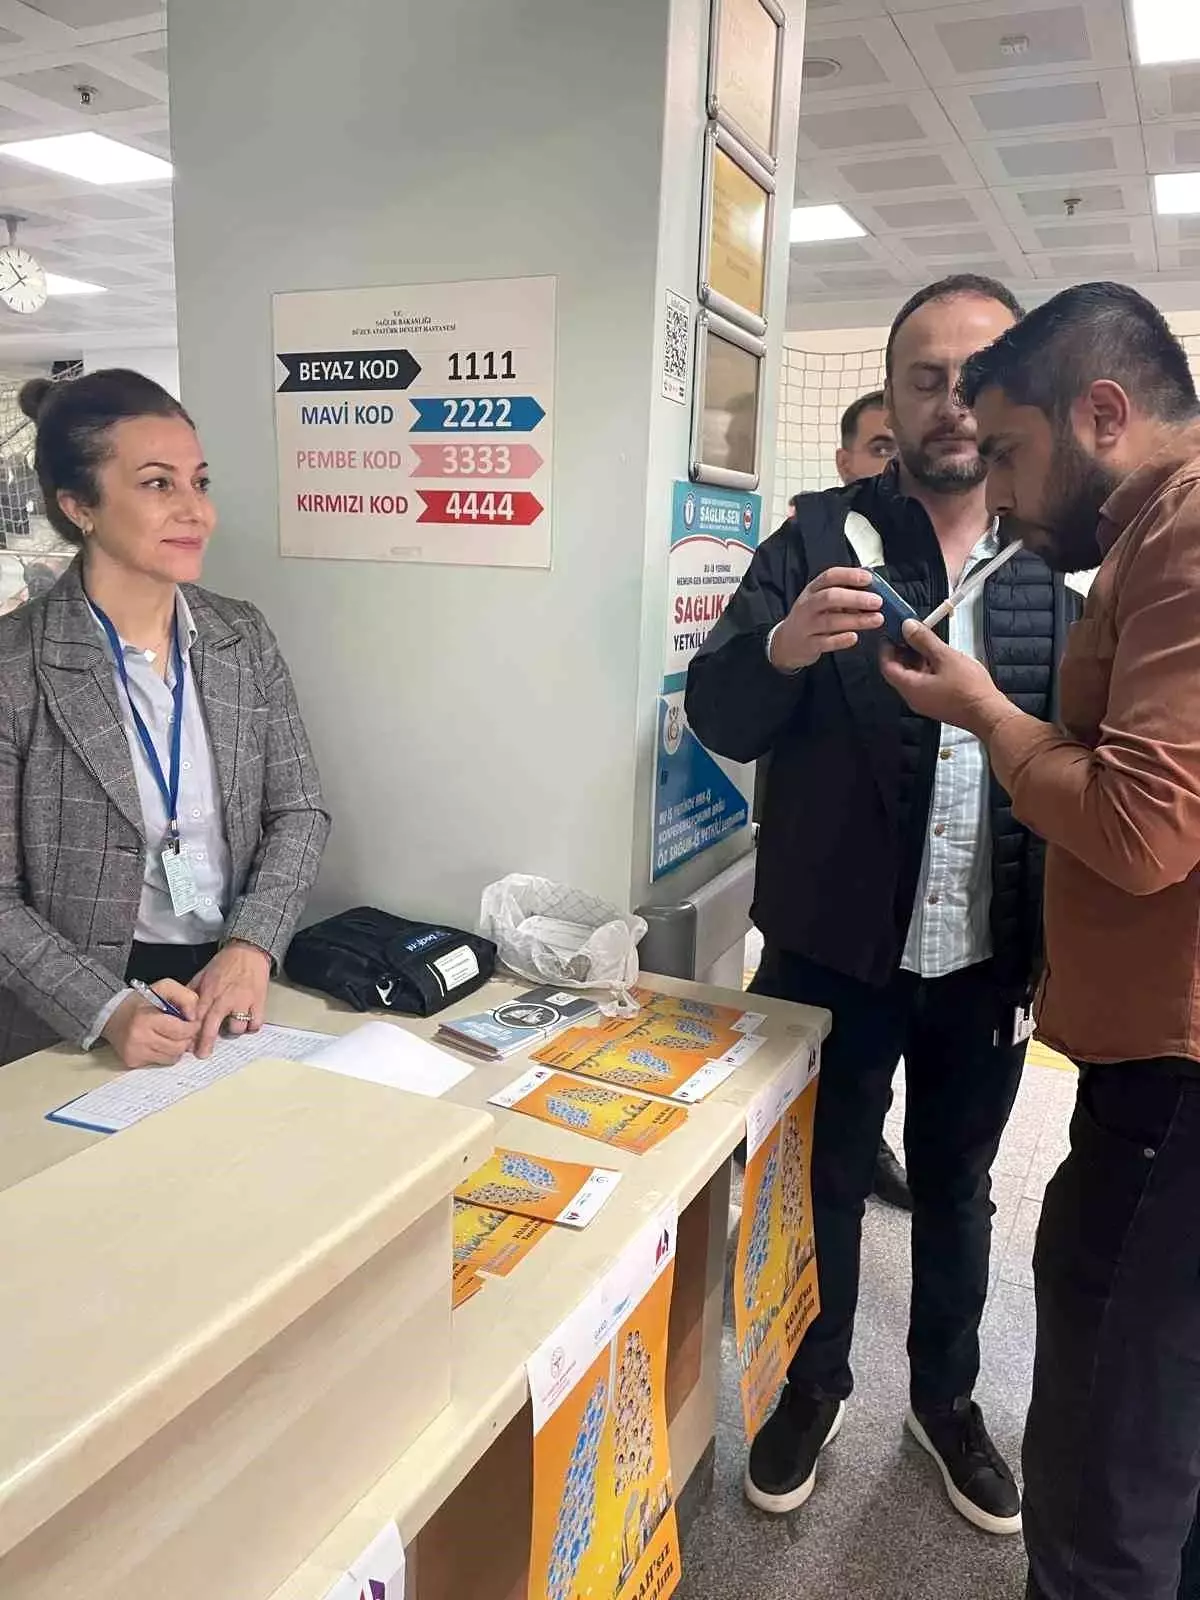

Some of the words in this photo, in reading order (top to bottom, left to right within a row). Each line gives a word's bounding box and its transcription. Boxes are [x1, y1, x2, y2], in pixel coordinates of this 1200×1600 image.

[299, 360, 354, 381] BEYAZ
[359, 359, 399, 380] KOD
[447, 350, 516, 380] 1111
[301, 401, 349, 425] MAVİ
[354, 405, 394, 425] KOD
[442, 399, 512, 428] 2222
[296, 450, 357, 469] PEMBE
[362, 450, 401, 470] KOD
[442, 446, 512, 474] 3333
[297, 494, 364, 513] KIRMIZI
[369, 495, 409, 514] KOD
[445, 492, 514, 520] 4444
[674, 592, 735, 625] SAĞLIK
